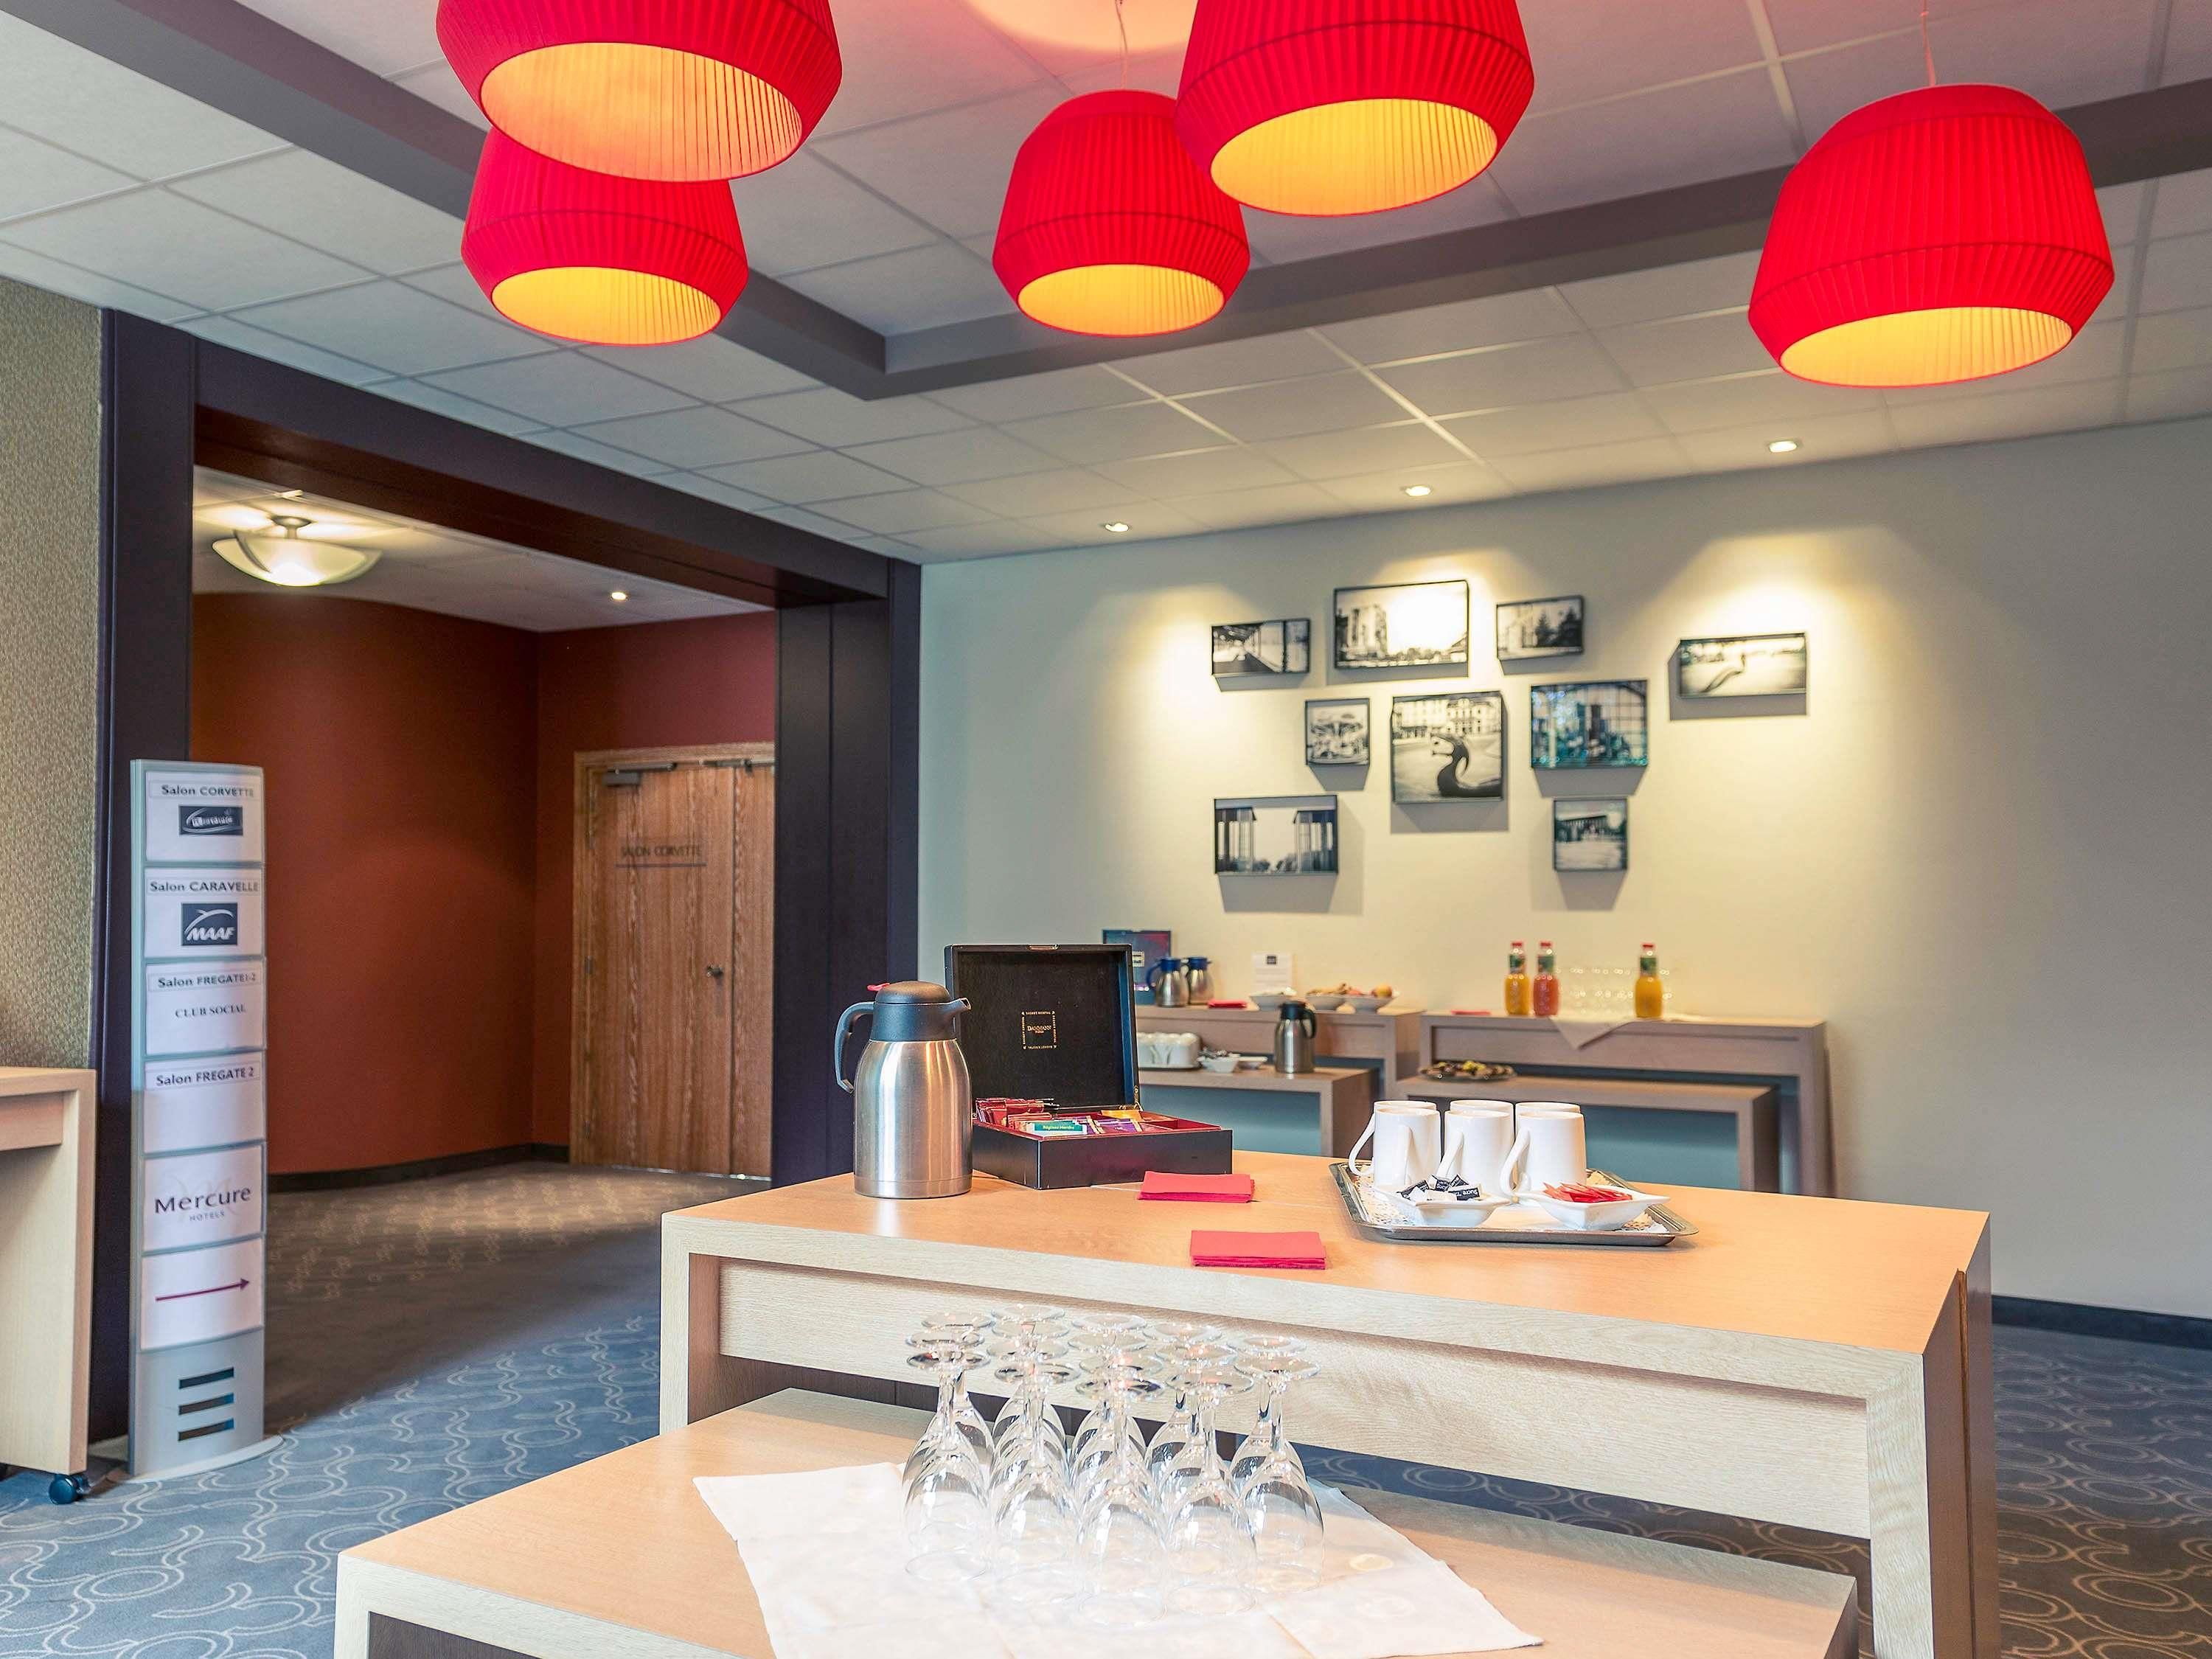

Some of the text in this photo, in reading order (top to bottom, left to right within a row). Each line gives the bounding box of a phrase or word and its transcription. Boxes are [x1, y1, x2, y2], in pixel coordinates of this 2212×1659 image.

[161, 784, 254, 797] Salon CORVETTE
[150, 881, 258, 892] Salon CARAVELLE
[187, 926, 235, 941] MAAF
[158, 977, 192, 988] Salon
[175, 1004, 246, 1018] CLUB SOCIAL
[156, 1067, 254, 1086] Salon FREGATE 2
[154, 1187, 251, 1214] Mercure
